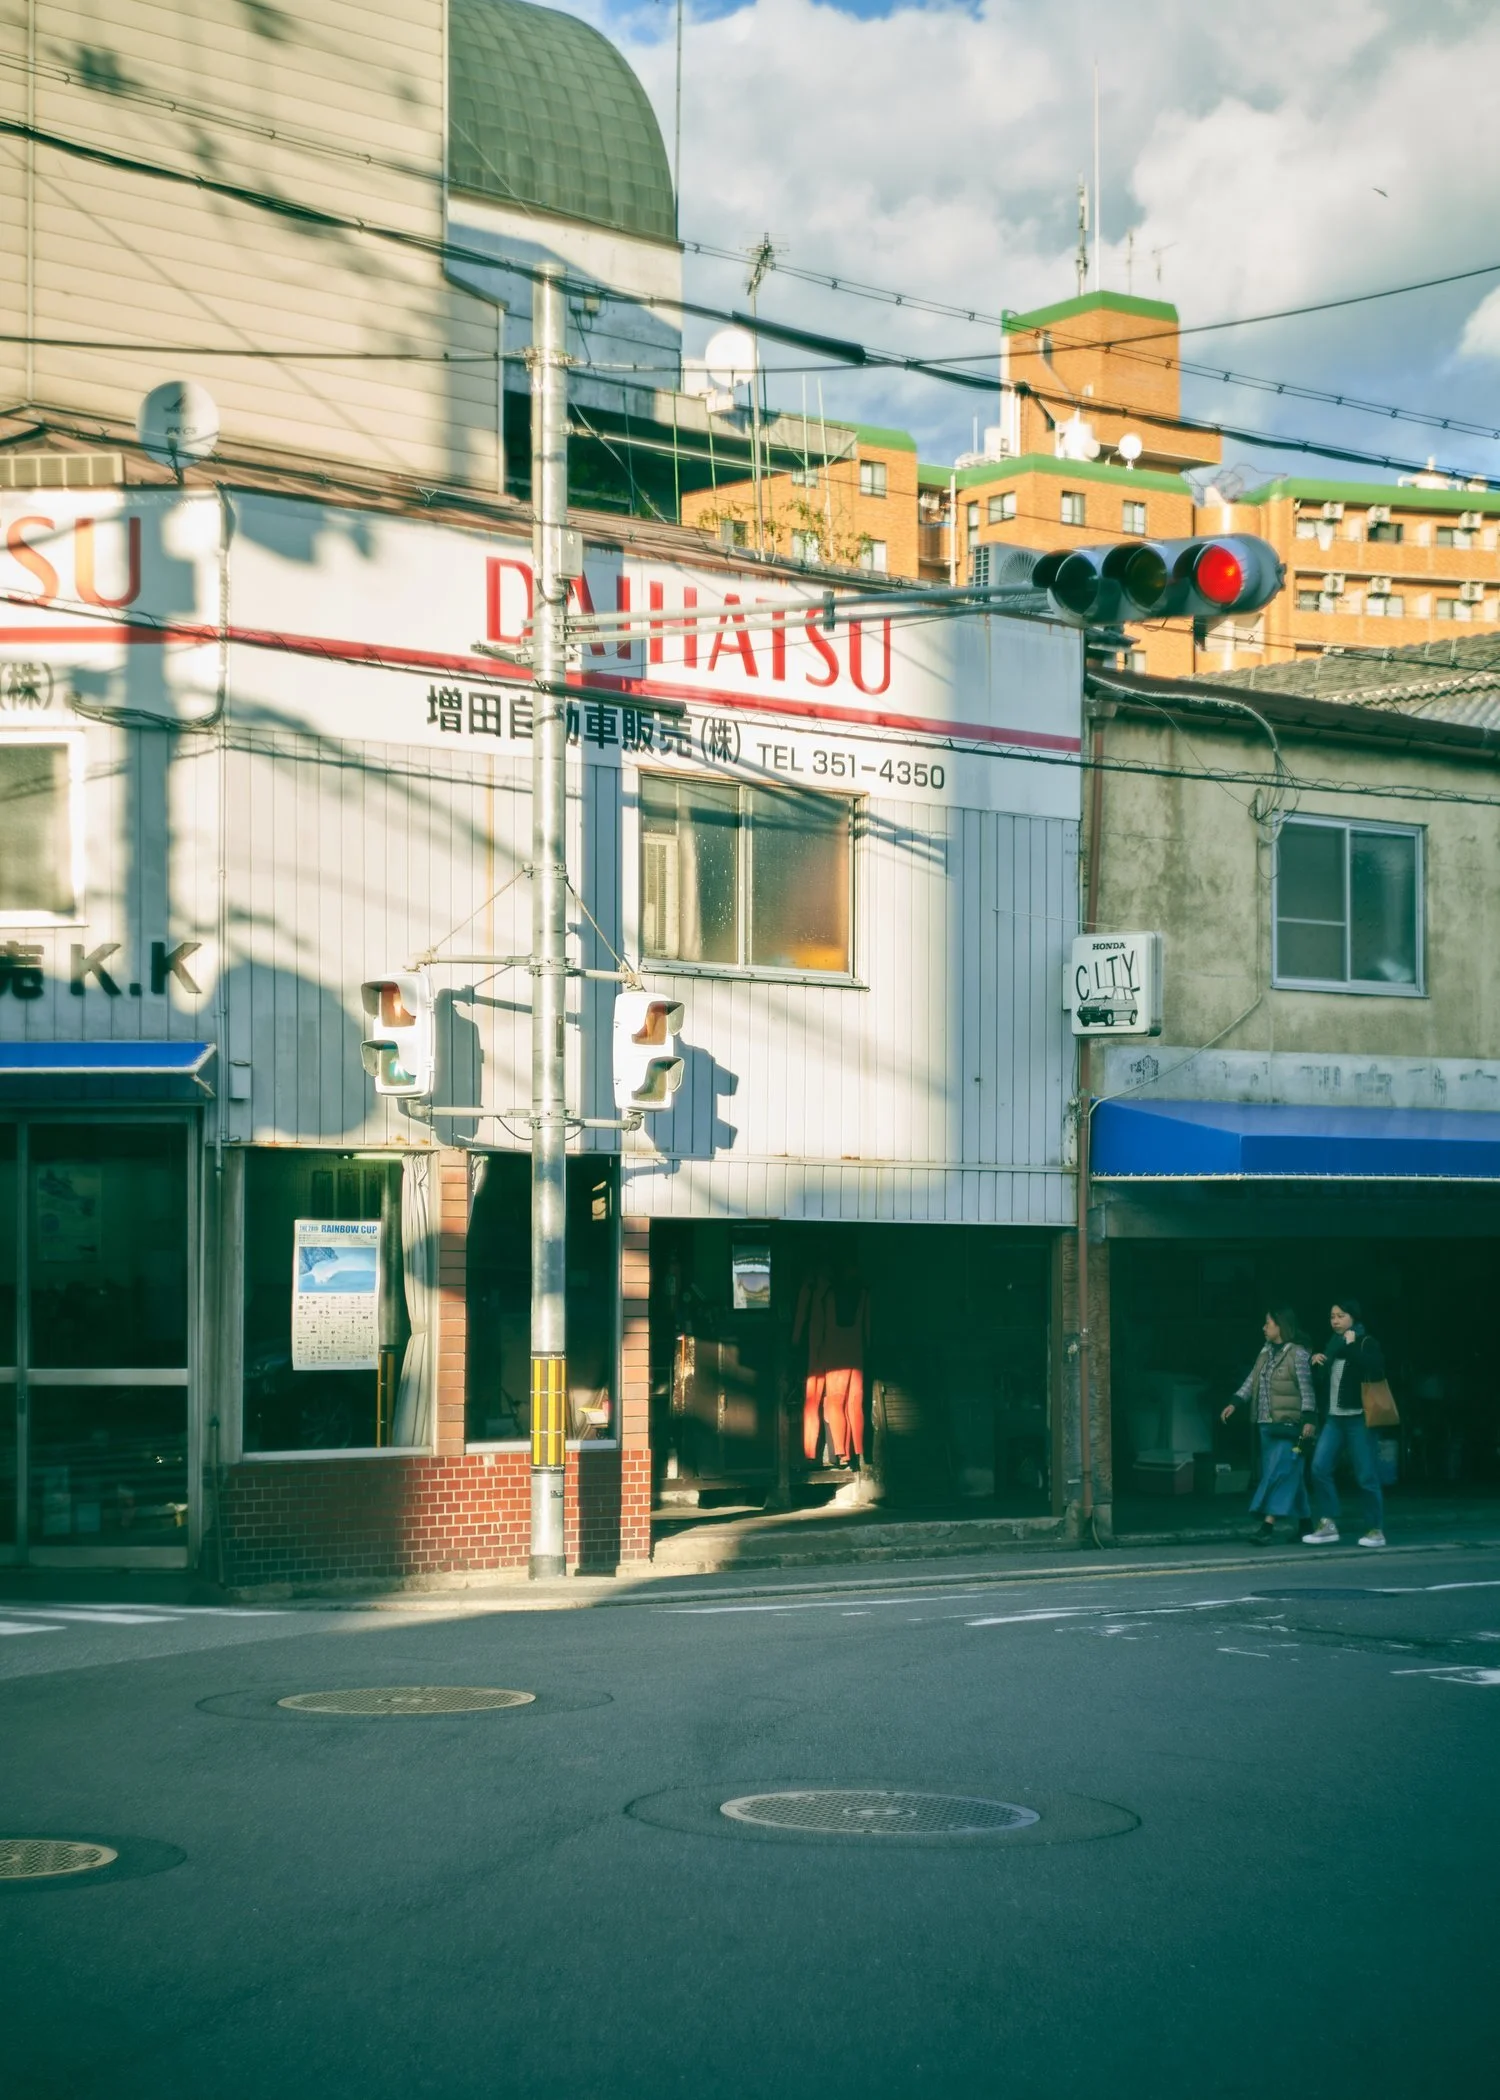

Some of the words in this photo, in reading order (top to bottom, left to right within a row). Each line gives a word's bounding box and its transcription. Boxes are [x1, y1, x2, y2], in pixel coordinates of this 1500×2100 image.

[0, 516, 141, 608] SU
[756, 742, 804, 772] TEL
[812, 749, 946, 790] 351-4350
[70, 941, 203, 997] K.K
[1092, 942, 1127, 950] HONDA
[1076, 950, 1141, 1001] CITY
[321, 1224, 359, 1234] RAINBOW
[360, 1225, 378, 1234] CUP
